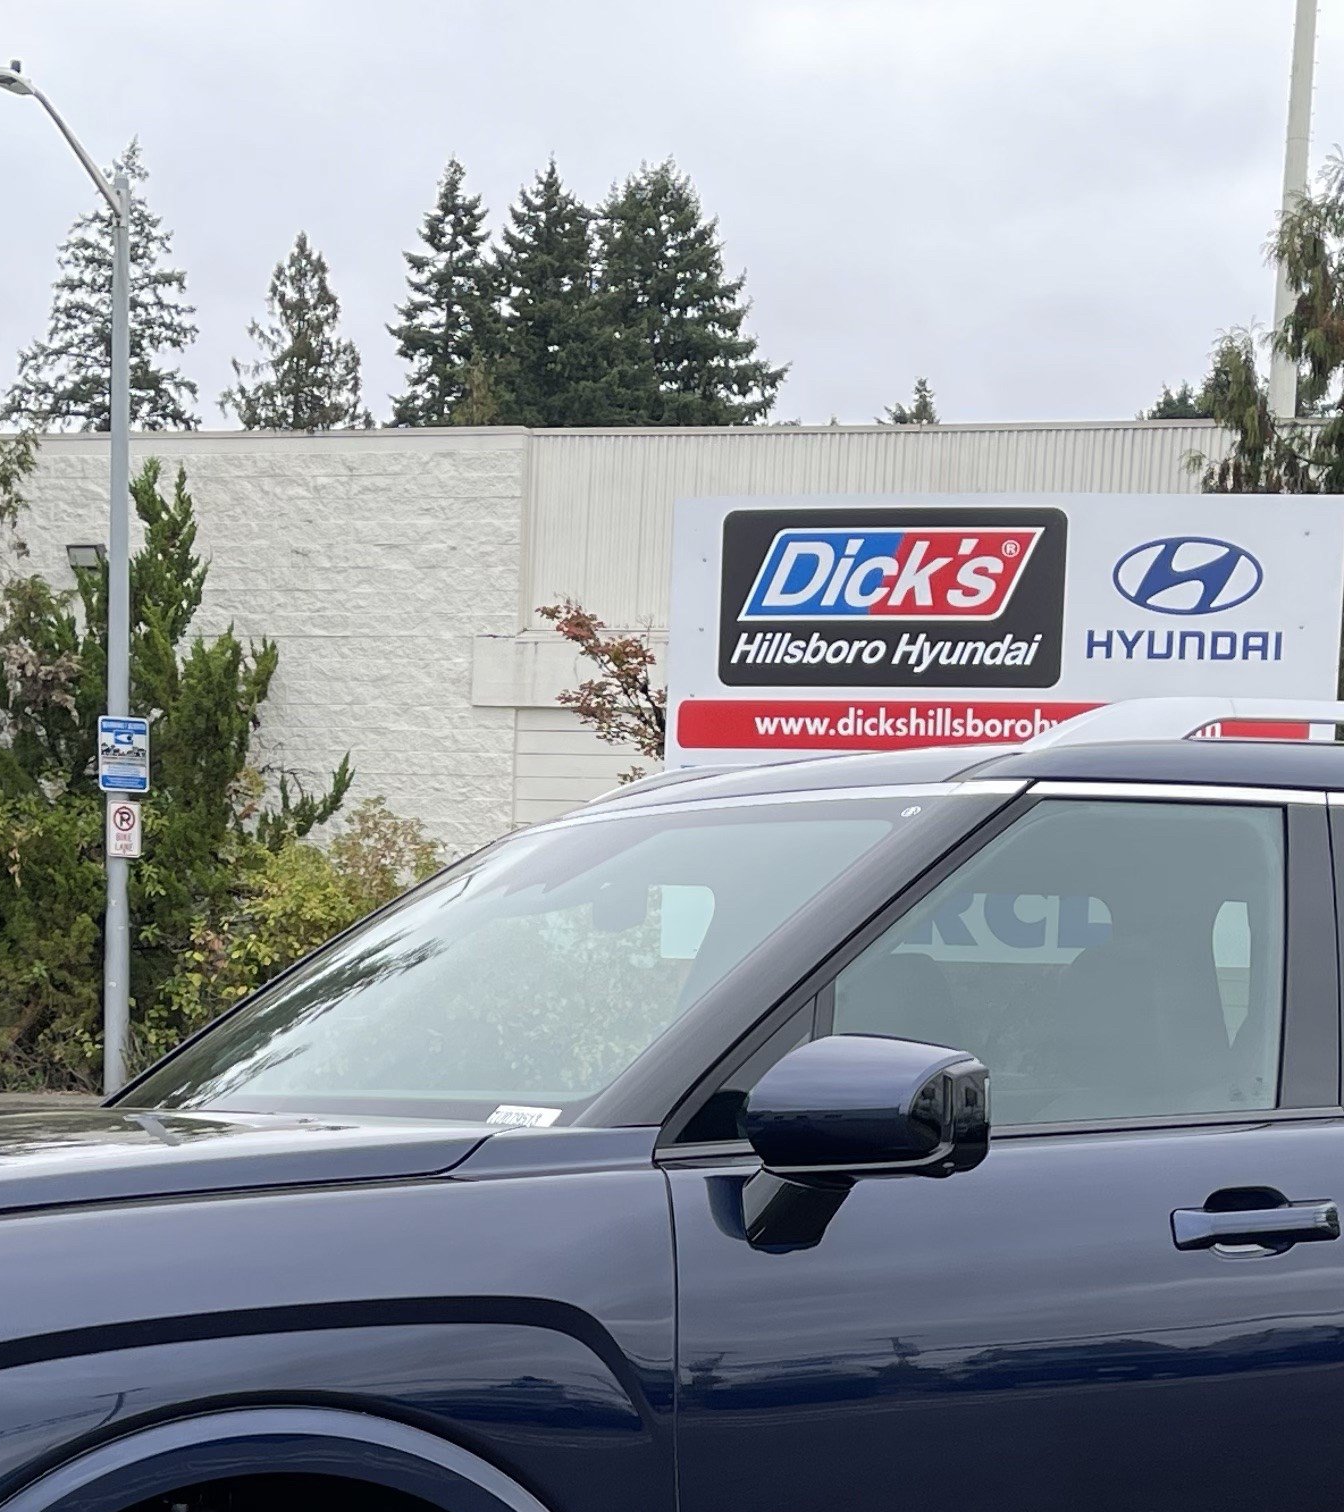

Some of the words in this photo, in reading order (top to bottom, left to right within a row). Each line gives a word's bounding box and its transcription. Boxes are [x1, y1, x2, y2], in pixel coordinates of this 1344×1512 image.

[730, 631, 887, 665] Hillsboro
[892, 633, 1043, 673] Hyundai
[1086, 629, 1283, 661] HYUNDAI
